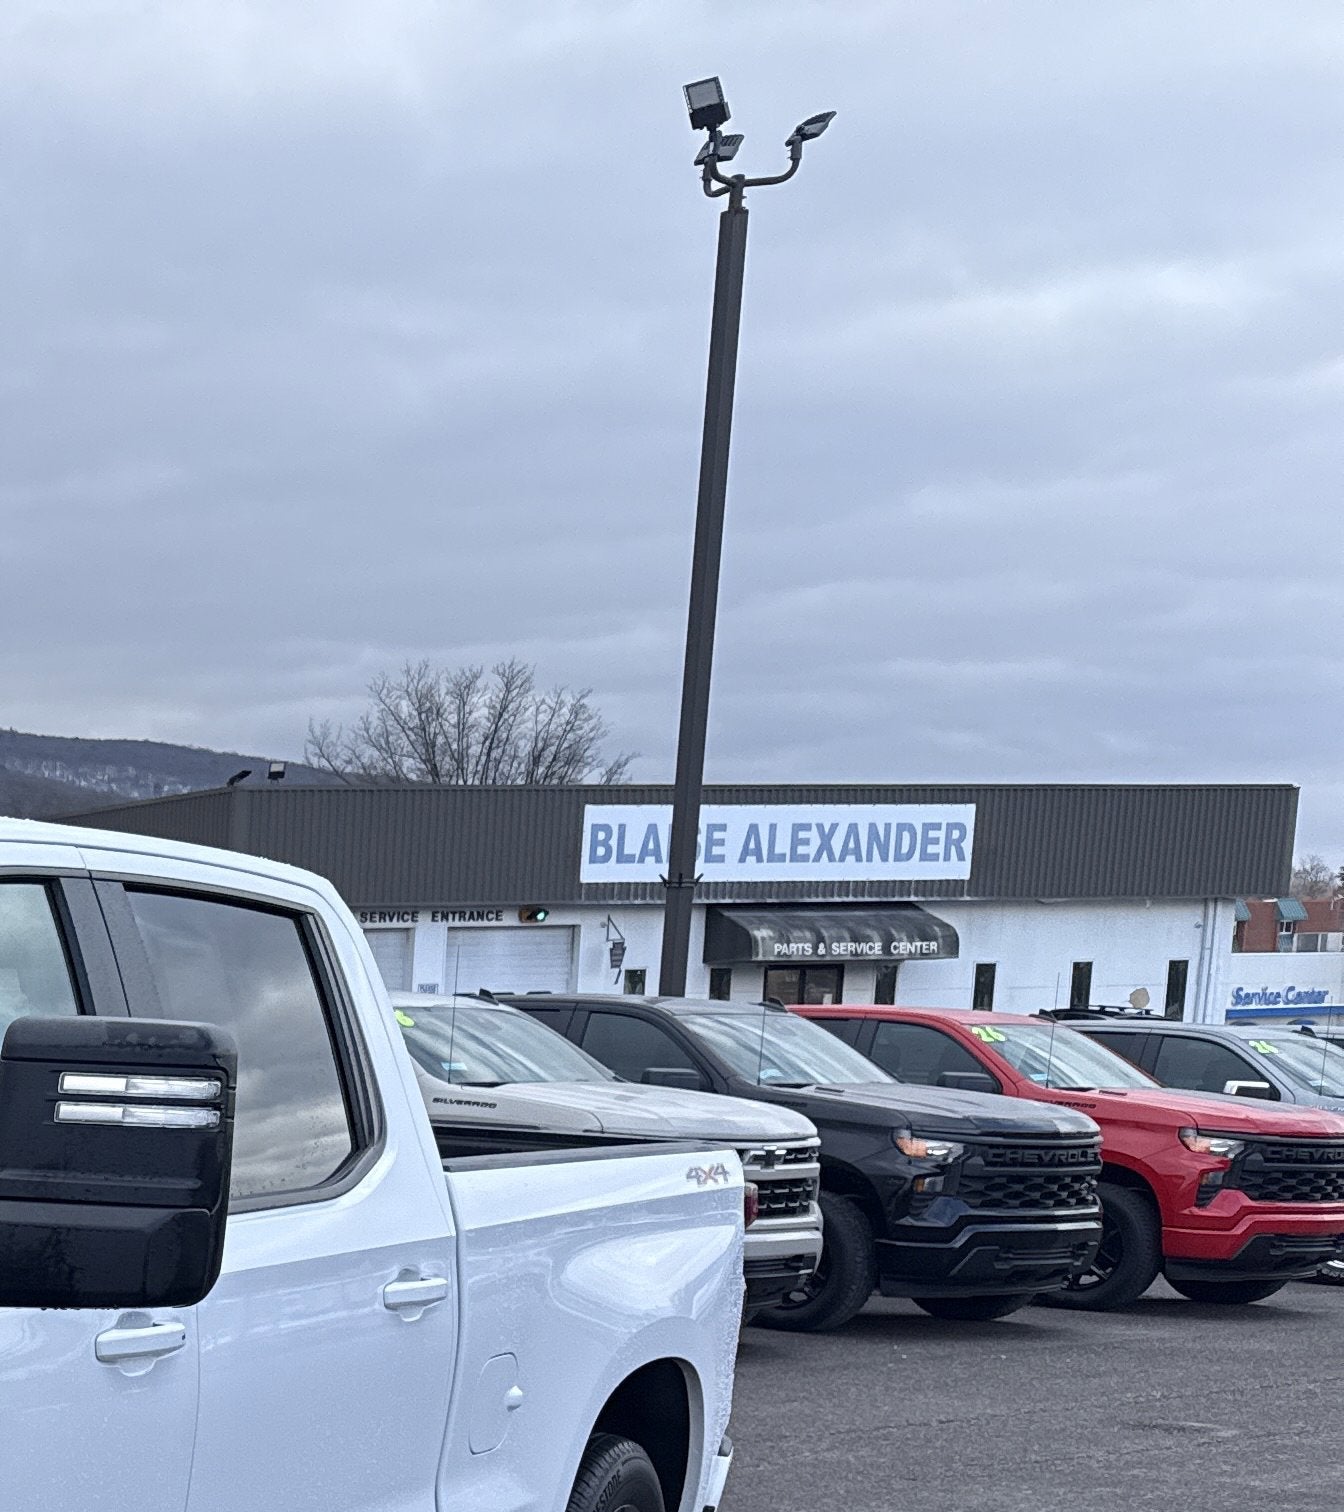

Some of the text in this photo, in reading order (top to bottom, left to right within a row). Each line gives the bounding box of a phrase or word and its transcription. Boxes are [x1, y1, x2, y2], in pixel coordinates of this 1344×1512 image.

[588, 822, 967, 864] BLAE ALEXANDER
[360, 909, 504, 923] SERVICE ENTRANCE
[774, 941, 938, 956] PARTS & SERVICE CENTER
[1231, 985, 1329, 1006] Service Center
[972, 1026, 1006, 1042] 26
[432, 1097, 497, 1109] SILVERADO
